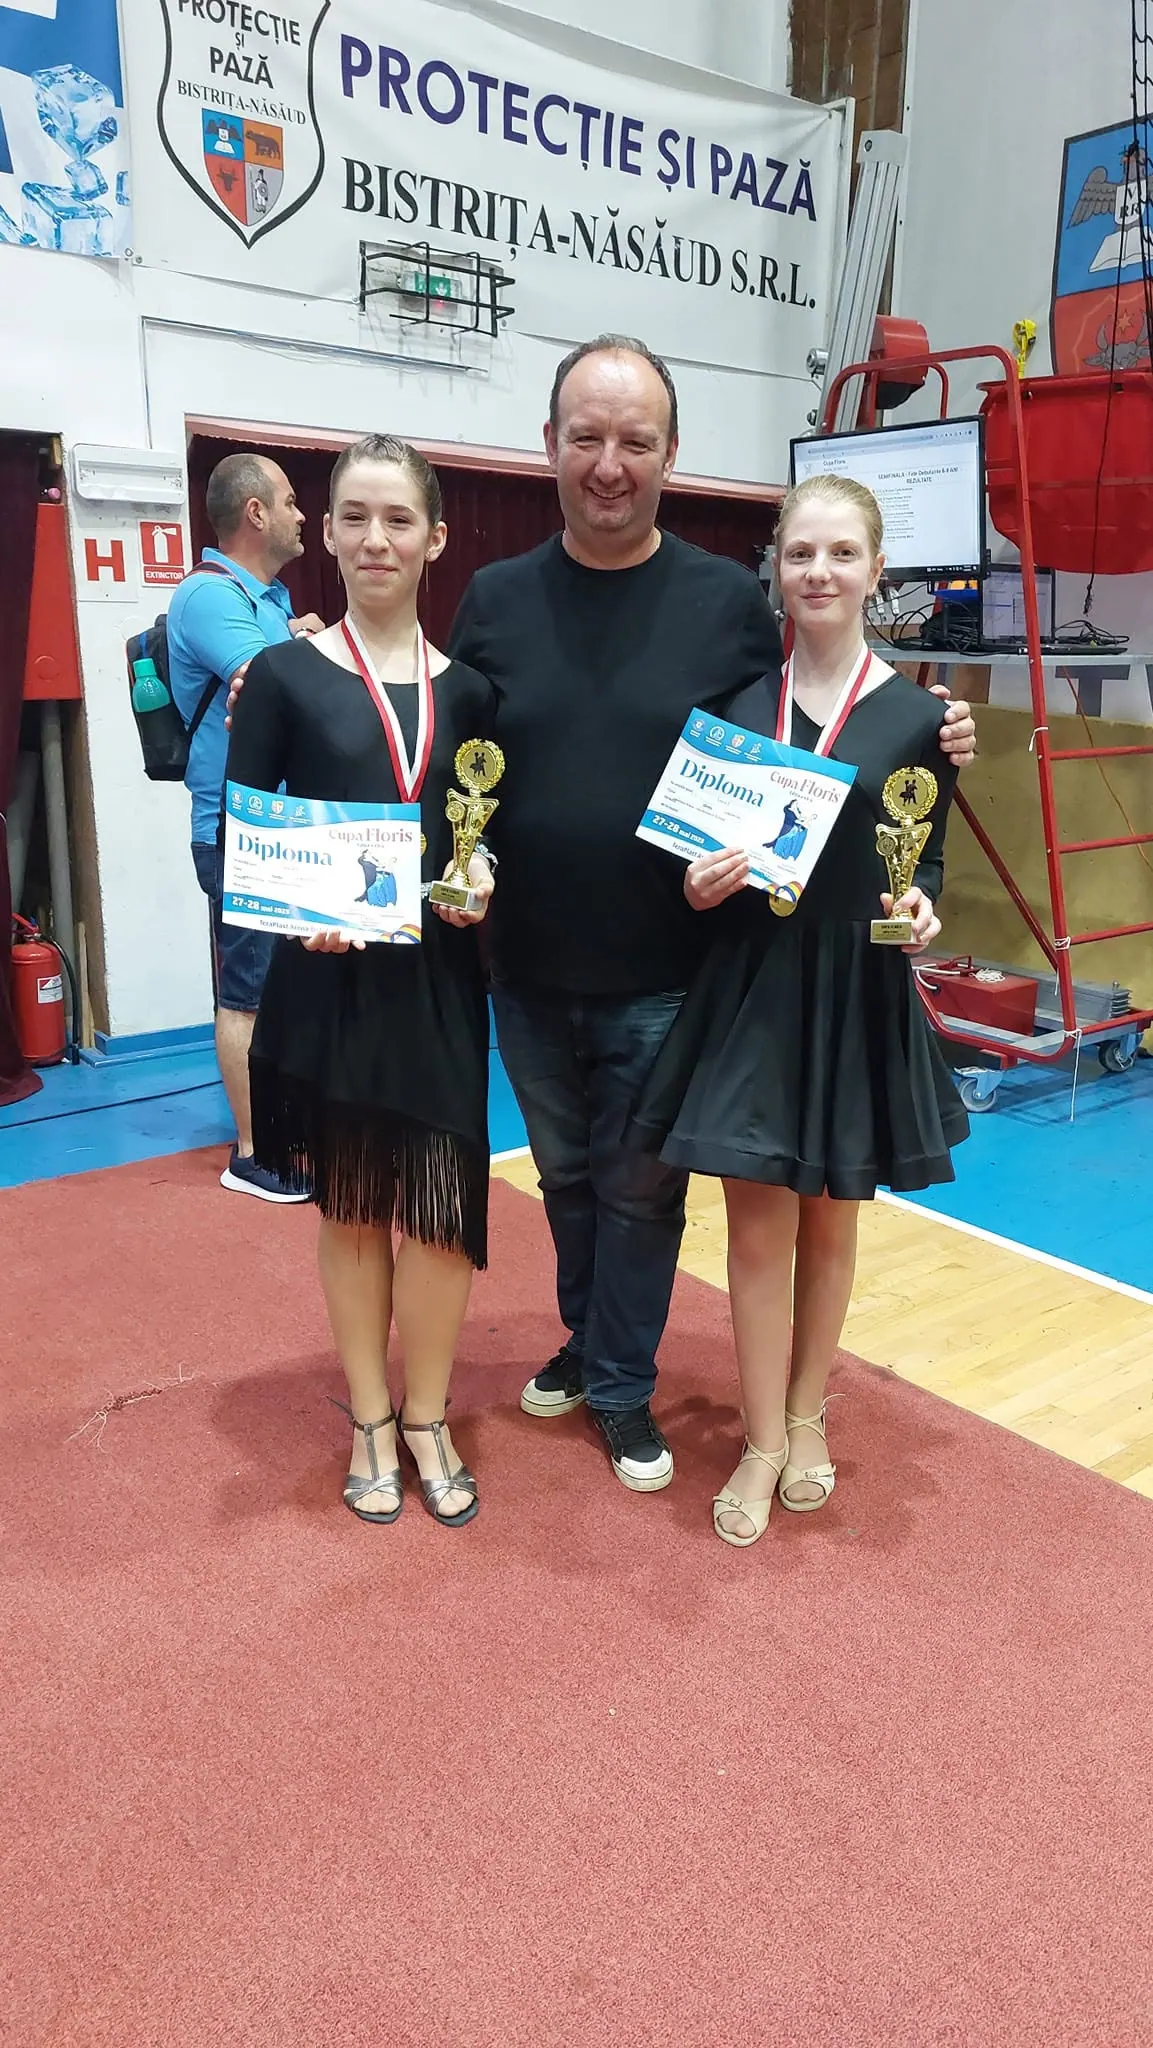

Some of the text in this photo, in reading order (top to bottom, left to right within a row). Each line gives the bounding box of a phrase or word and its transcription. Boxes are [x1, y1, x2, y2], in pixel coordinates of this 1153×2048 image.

[235, 32, 245, 50] ȘI
[209, 46, 274, 89] PAZĂ
[177, 79, 307, 125] BISTRIȚA-NĂSĂUD
[341, 33, 817, 222] PROTECȚIE ȘI PAZĂ
[341, 156, 816, 309] BISTRIȚA-NĂSĂUD S.R.L.
[84, 538, 126, 582] H
[145, 570, 184, 580] EXTINCTOR
[679, 758, 764, 807] Diploma
[770, 771, 841, 803] Cupa Floris
[329, 828, 413, 843] Cupa Floris
[652, 815, 680, 833] 27-28
[238, 833, 332, 866] Diploma
[232, 895, 260, 911] 27-28
